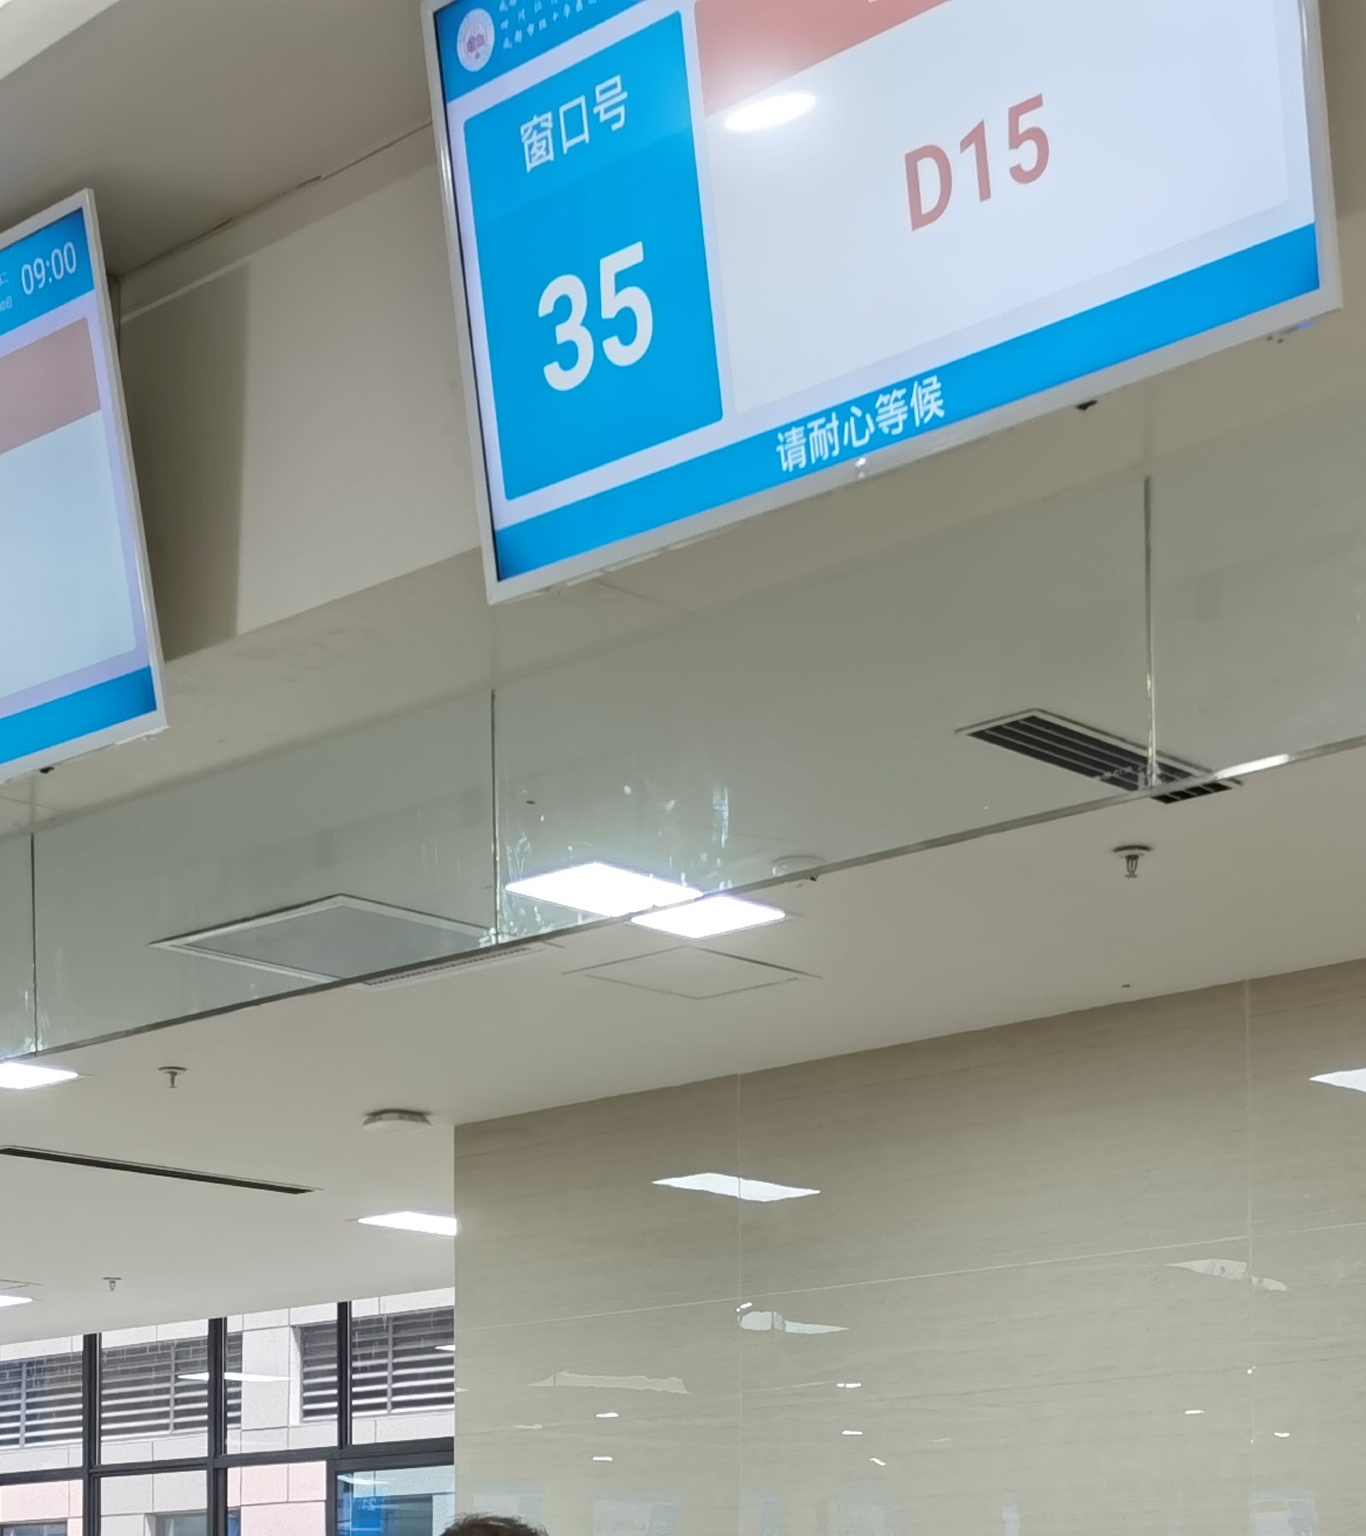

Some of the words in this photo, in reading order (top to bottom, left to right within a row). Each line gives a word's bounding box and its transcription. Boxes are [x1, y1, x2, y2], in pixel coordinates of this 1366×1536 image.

[520, 75, 628, 173] 窗口号
[904, 93, 1051, 232] D15
[21, 241, 77, 296] 09:00
[537, 242, 653, 392] 35
[775, 376, 946, 474] 请耐心等候
